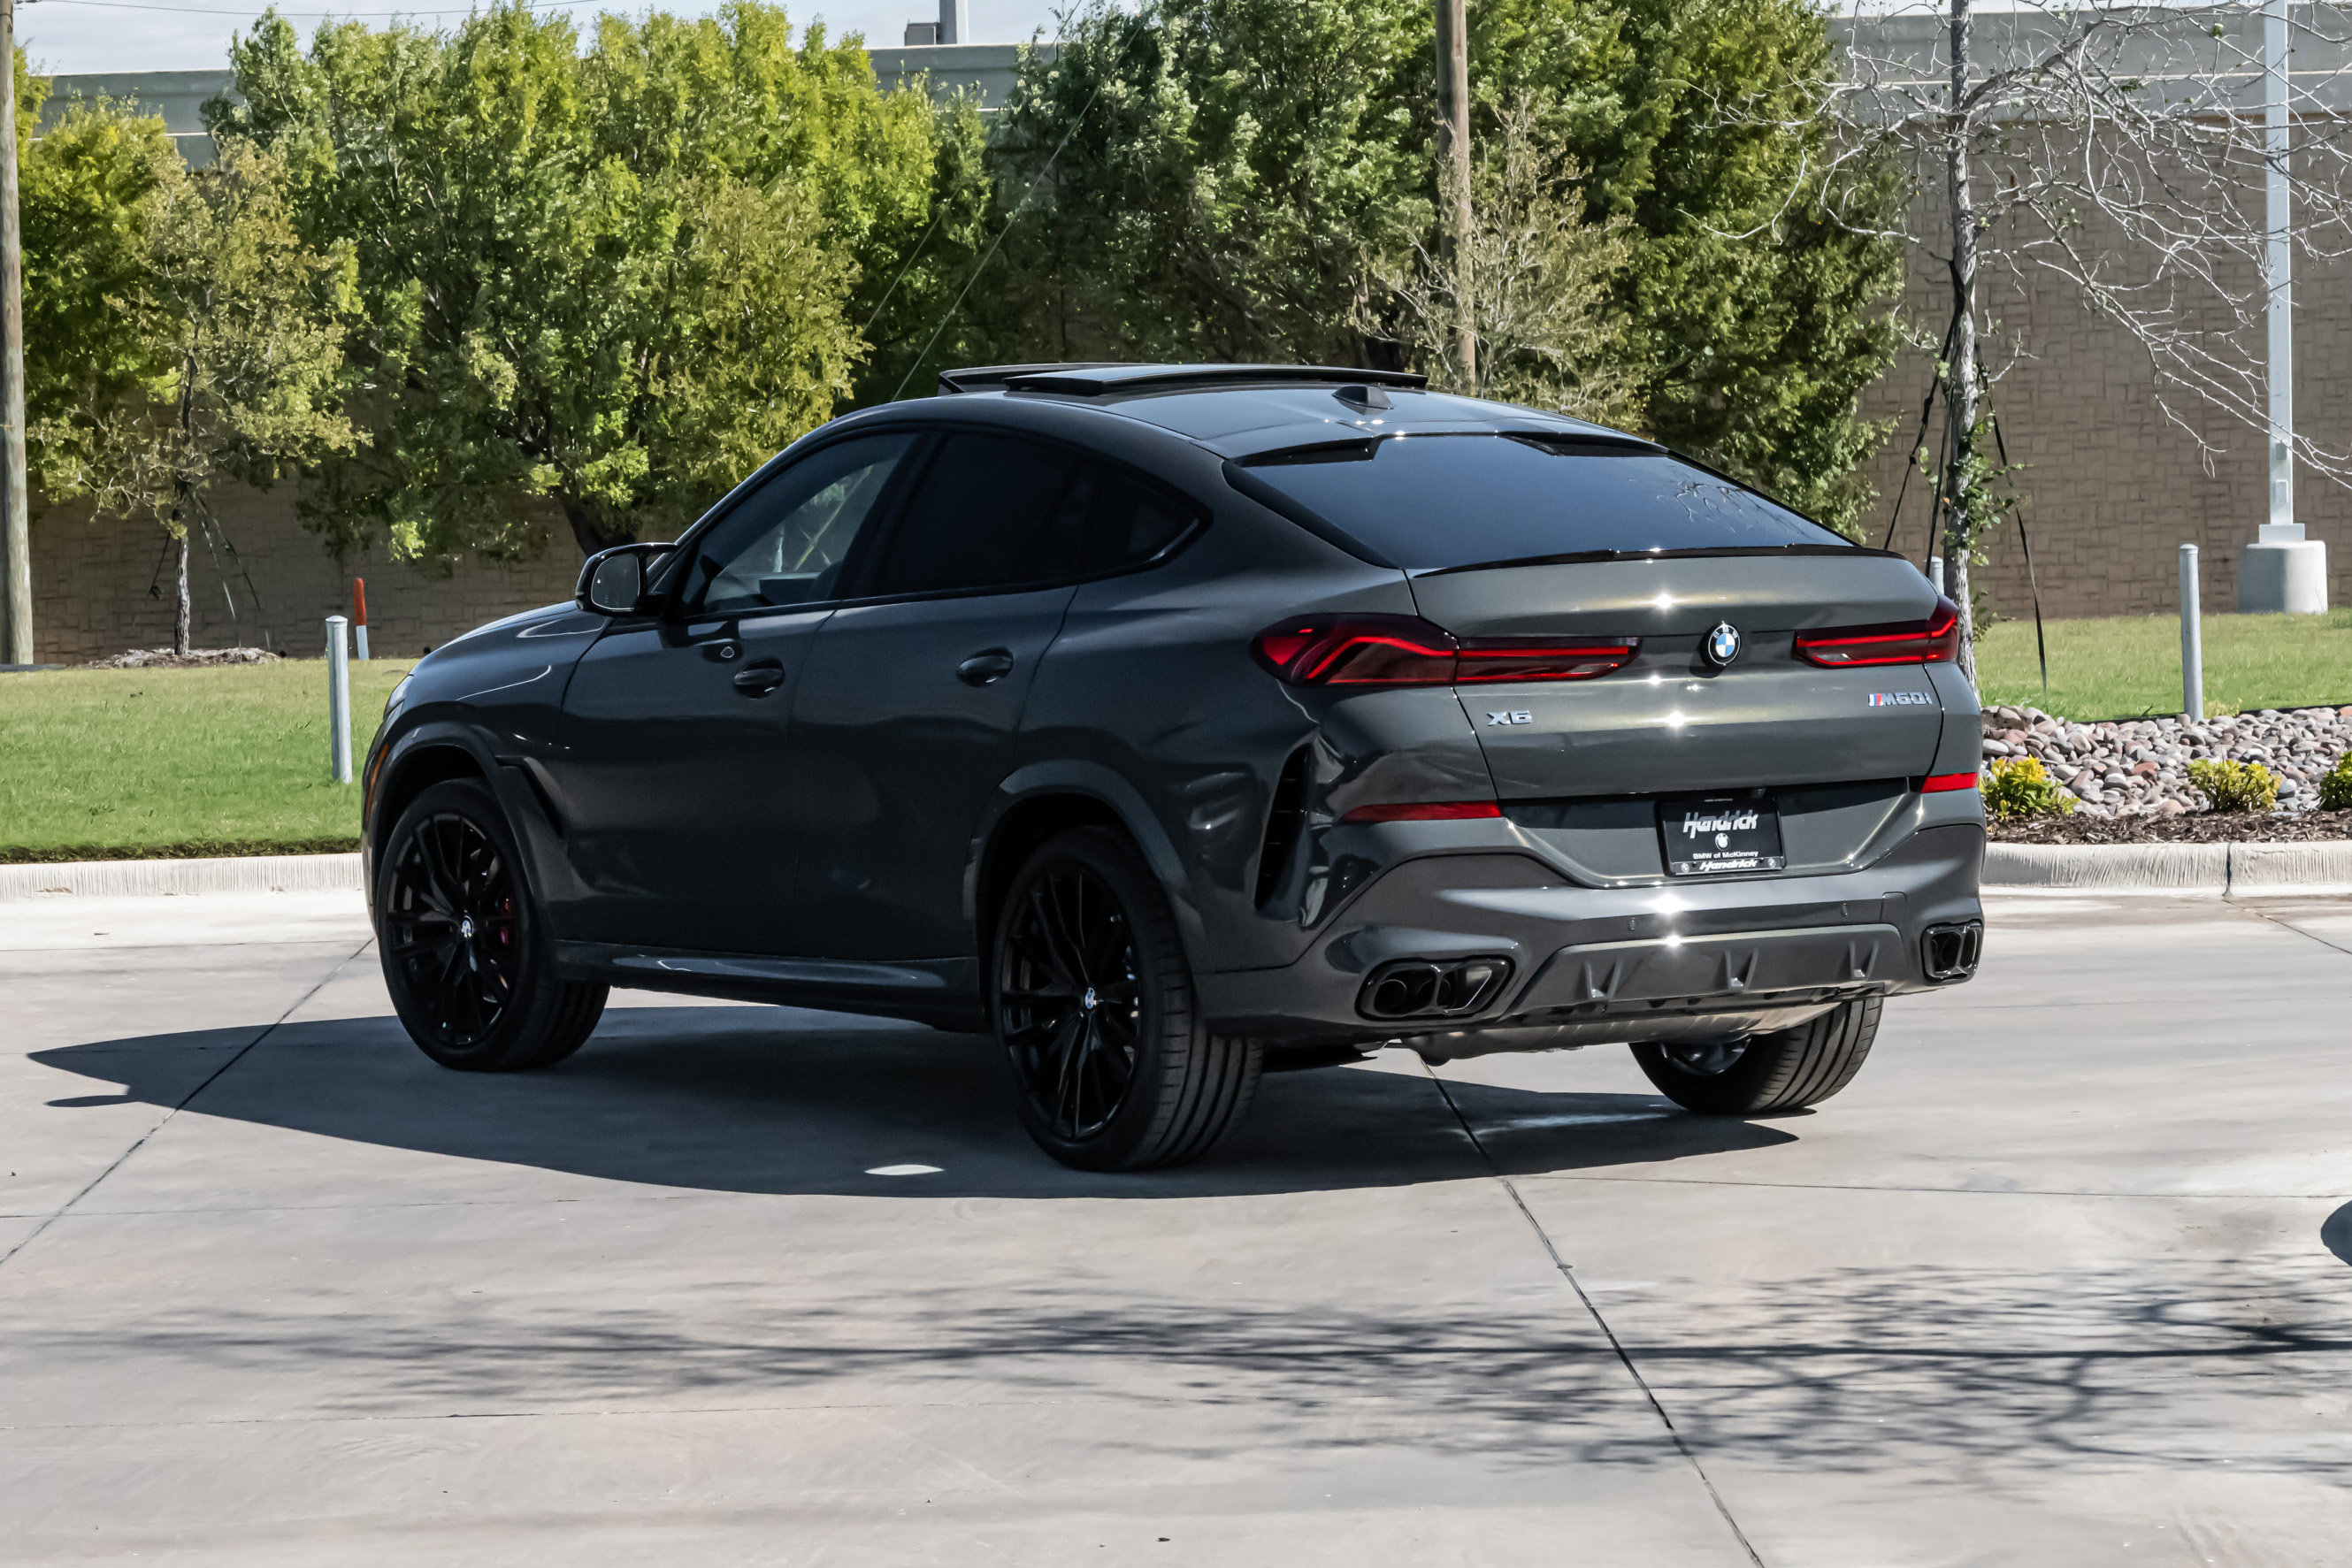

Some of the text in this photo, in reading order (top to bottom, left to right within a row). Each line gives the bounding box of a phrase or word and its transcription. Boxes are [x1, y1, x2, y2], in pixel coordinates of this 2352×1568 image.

[1486, 710, 1532, 726] X6
[1682, 809, 1758, 839] Hendrick
[1699, 860, 1758, 872] Hendrick
